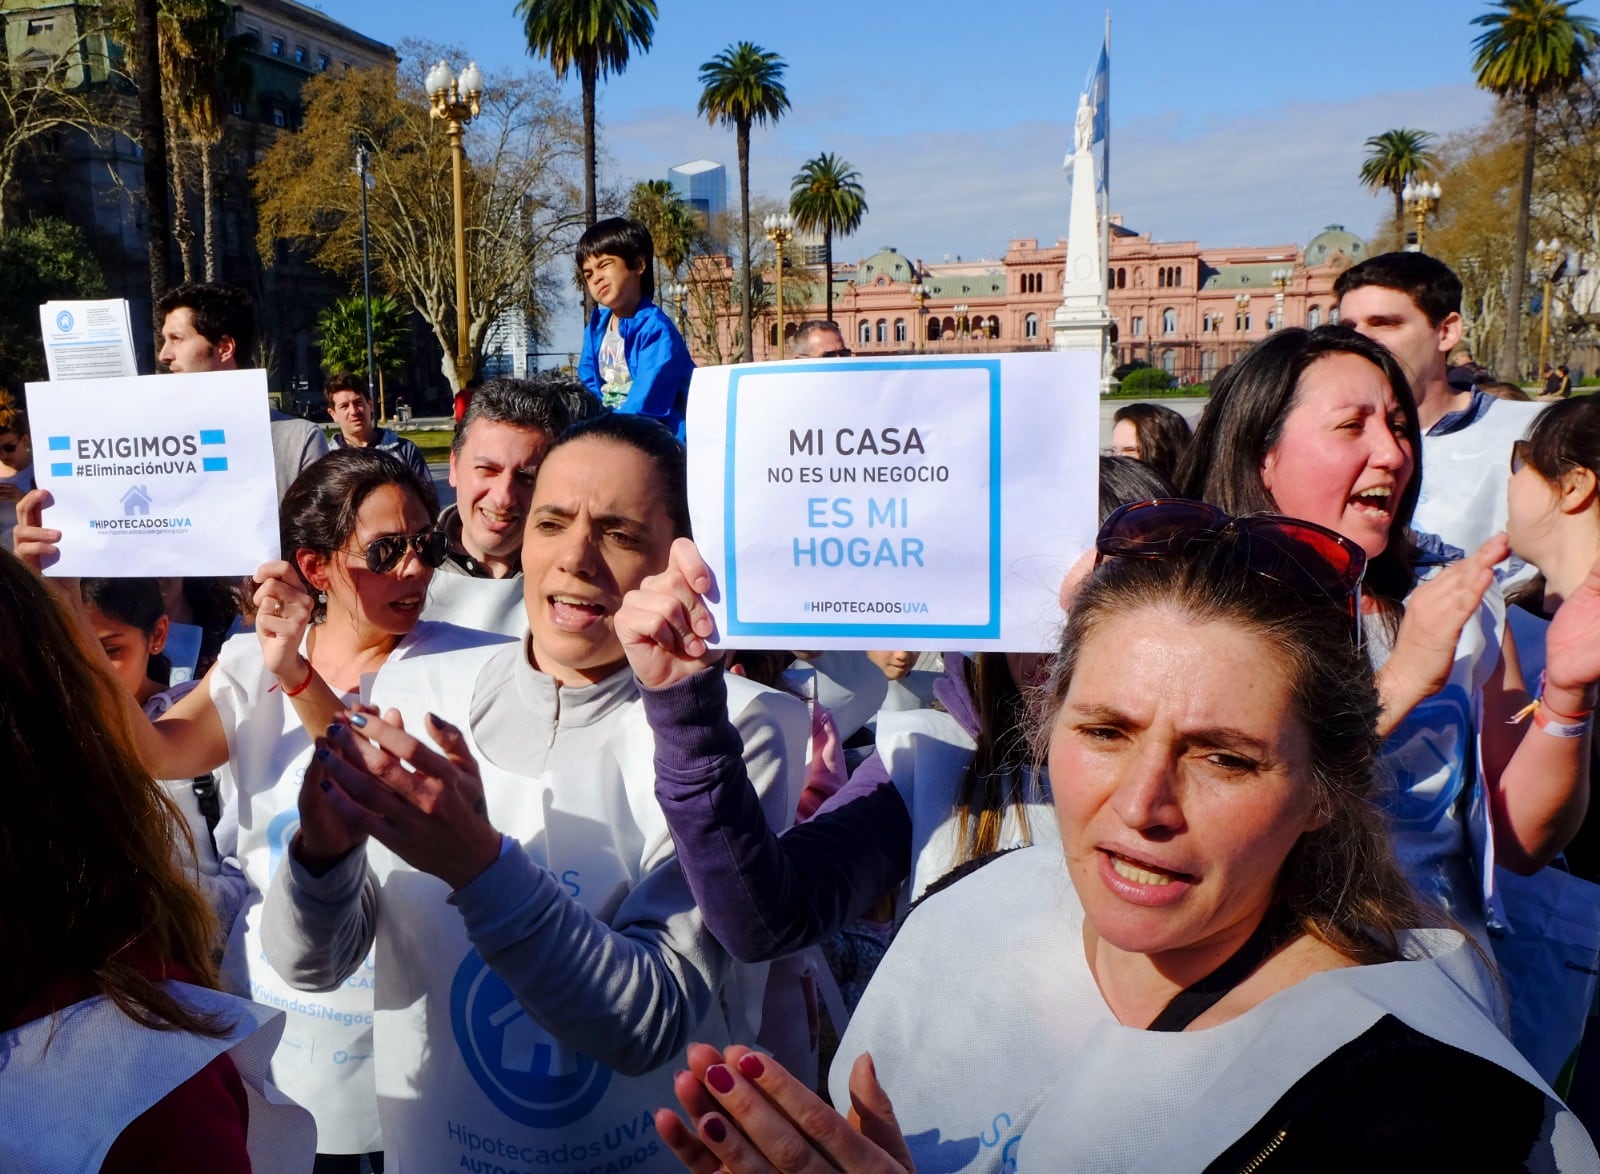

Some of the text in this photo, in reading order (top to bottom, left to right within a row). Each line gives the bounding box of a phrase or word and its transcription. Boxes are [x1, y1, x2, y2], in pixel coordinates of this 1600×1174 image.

[77, 434, 198, 460] EXIGIMOS
[789, 427, 925, 456] MI CASA
[76, 460, 197, 477] #EliminaciónUVA
[767, 465, 950, 483] NO ES UN NEGOCIO
[89, 517, 192, 530] #HIPOTECADOSUVA
[807, 497, 908, 529] ES MI
[793, 537, 925, 568] HOGAR
[803, 601, 929, 614] #HIPOTECADOSUVA
